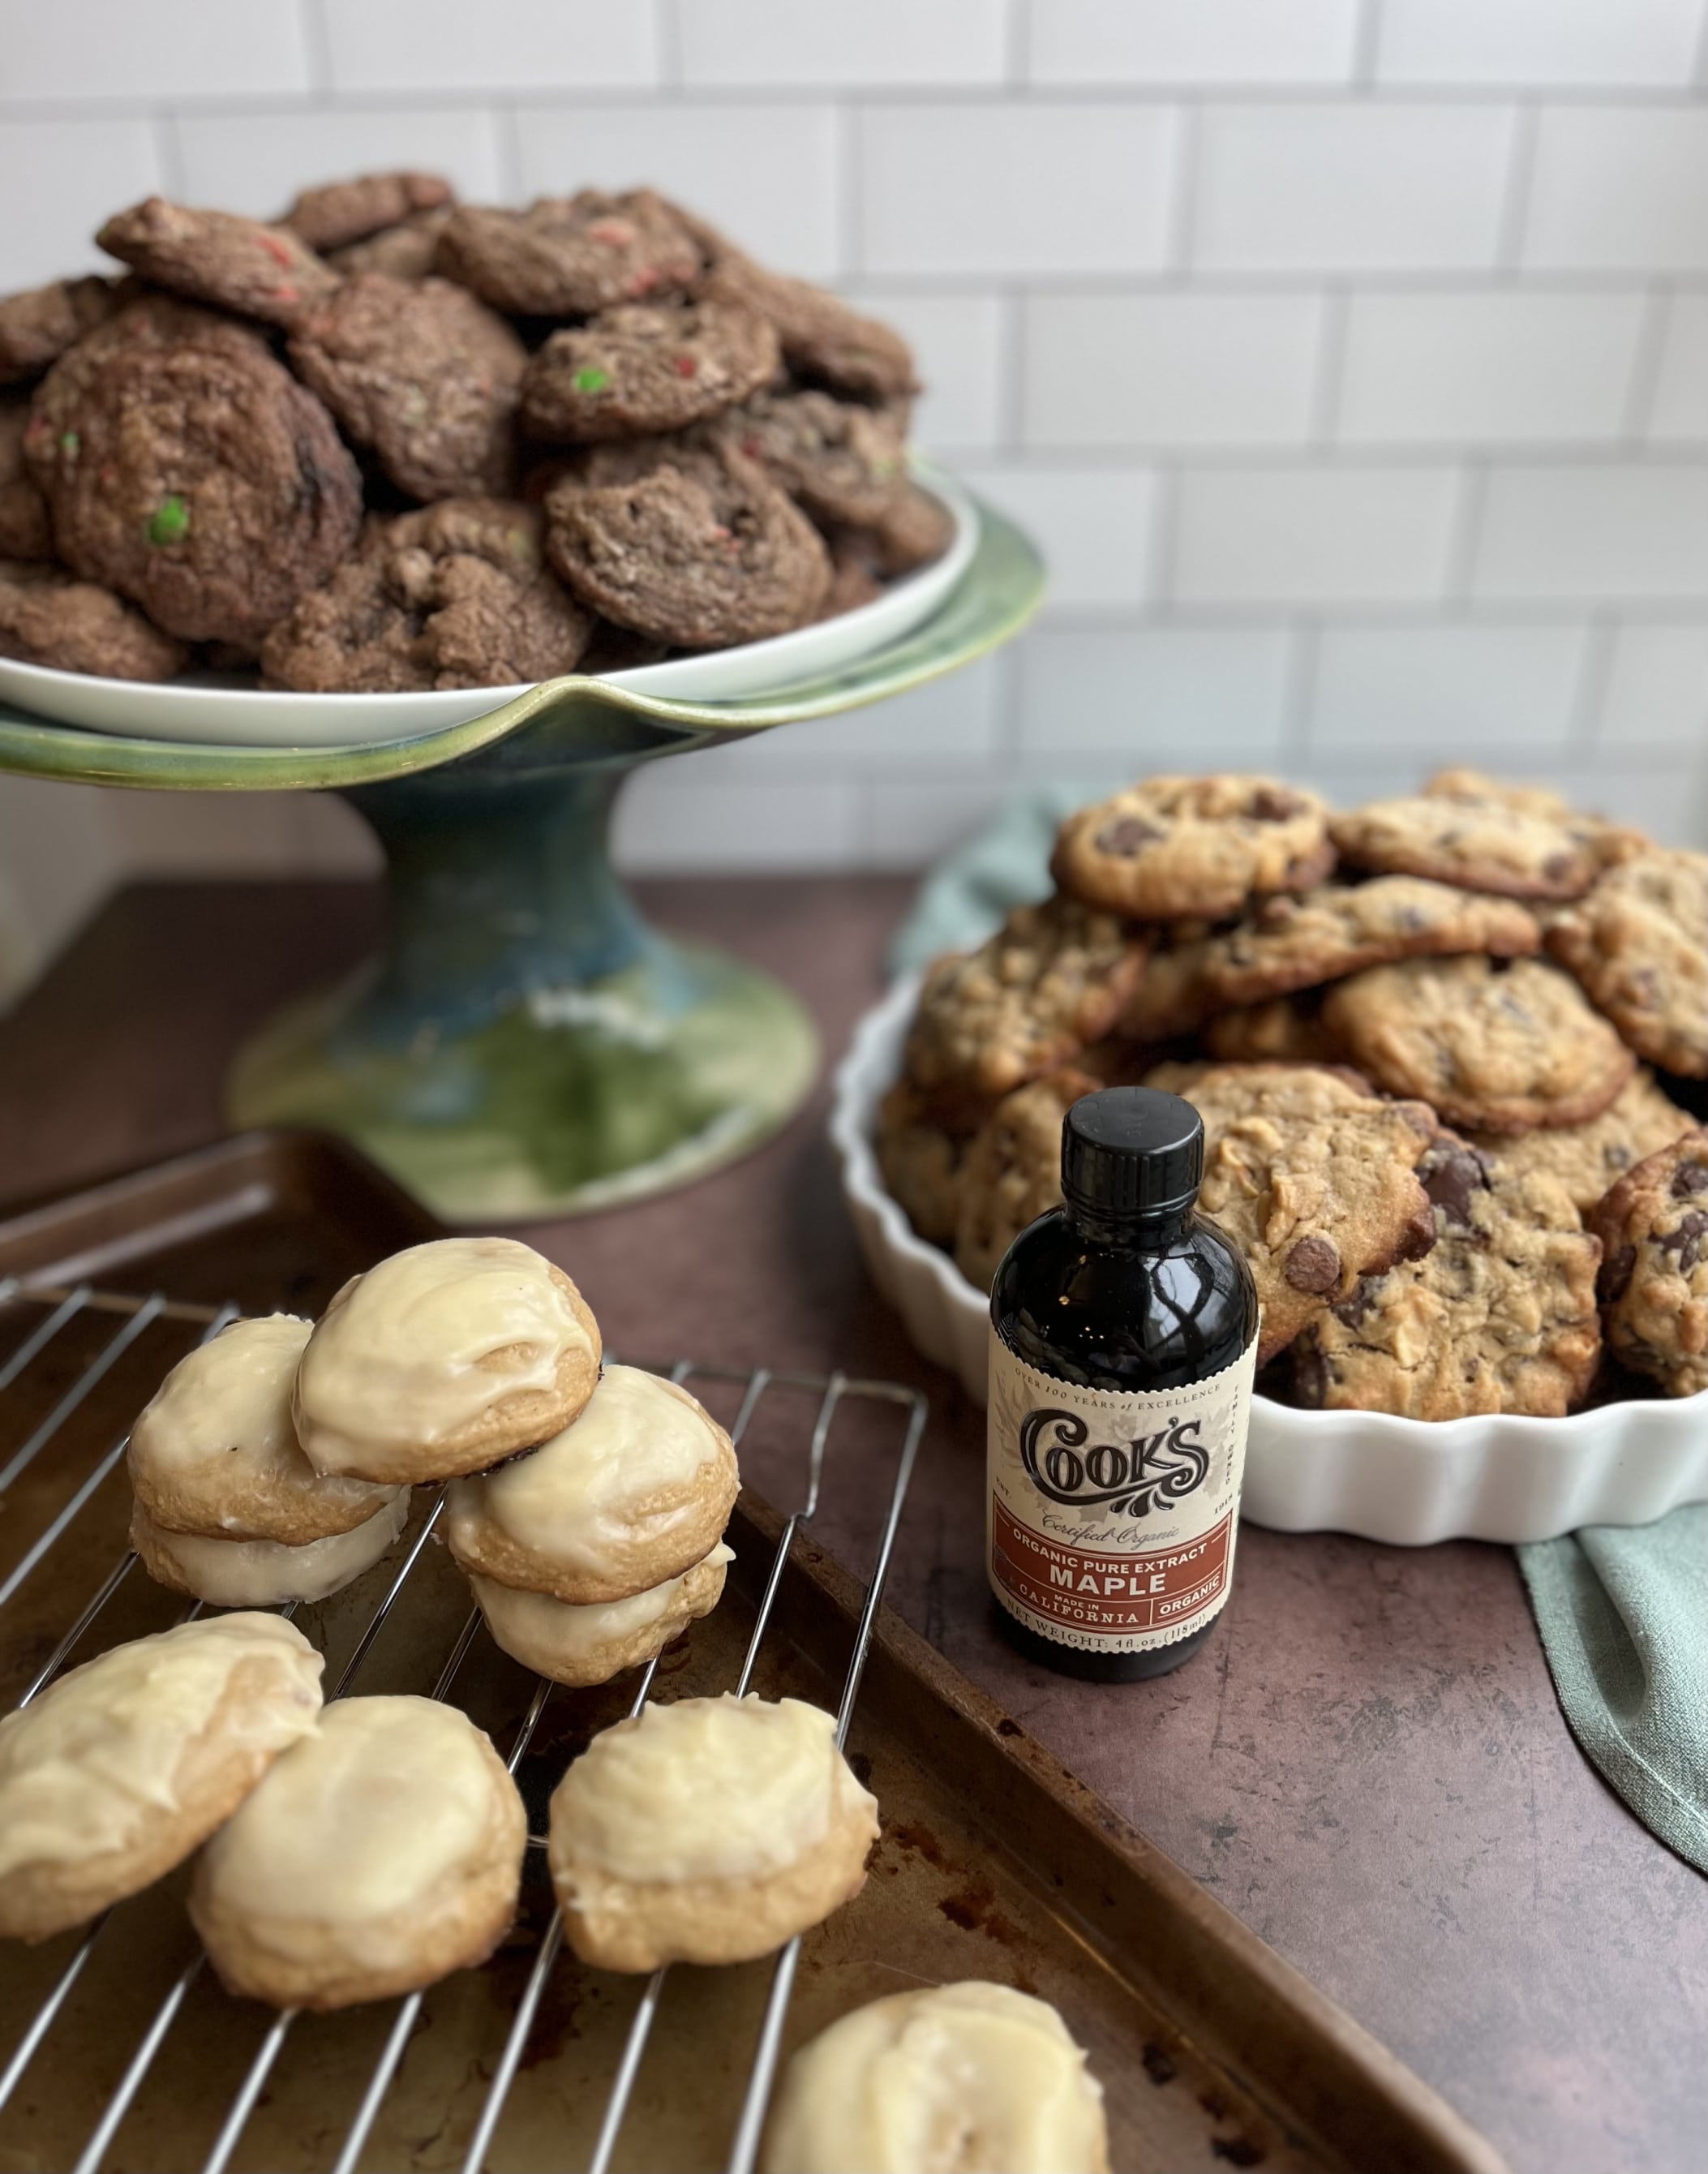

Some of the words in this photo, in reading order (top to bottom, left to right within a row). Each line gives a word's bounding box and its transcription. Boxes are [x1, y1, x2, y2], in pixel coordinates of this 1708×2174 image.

[1015, 1368, 1041, 1389] OVER
[1045, 1386, 1067, 1399] 100
[1074, 1395, 1115, 1409] YEARS
[1121, 1403, 1132, 1411] of
[1138, 1384, 1220, 1410] EXCELLENCE
[1042, 1509, 1116, 1545] Certified
[1116, 1522, 1180, 1550] Organic
[1013, 1528, 1079, 1568] ORGANIC
[1083, 1559, 1130, 1575] PURE
[1135, 1543, 1208, 1574] EXTRACT
[1049, 1564, 1166, 1596] MAPLE
[1159, 1575, 1220, 1615] ORGANIC
[1007, 1597, 1030, 1622] NET
[1036, 1619, 1108, 1648] WEIGHT:
[1019, 1583, 1139, 1623] CALIFORNIA
[1054, 1594, 1085, 1609] MADE
[1088, 1603, 1100, 1611] IN
